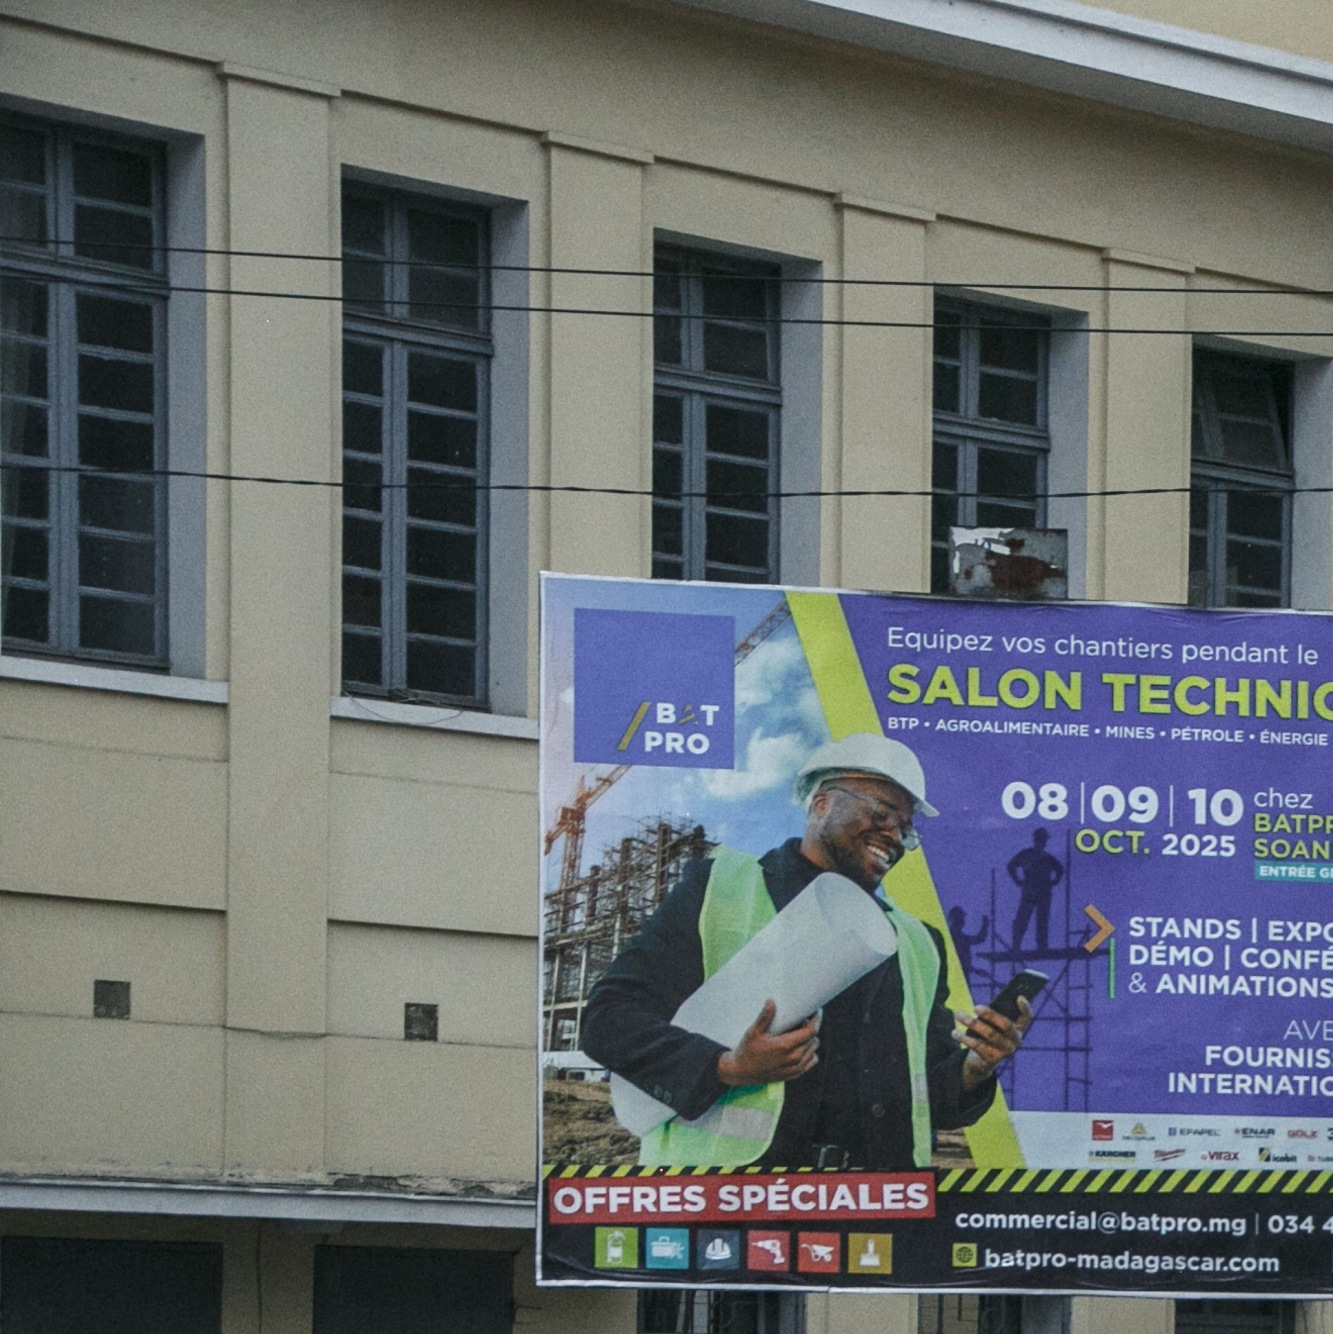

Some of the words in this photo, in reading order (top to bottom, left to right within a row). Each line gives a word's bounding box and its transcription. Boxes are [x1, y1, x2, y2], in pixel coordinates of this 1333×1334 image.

[888, 627, 993, 653] Equipez
[1002, 636, 1046, 654] vos
[1055, 634, 1173, 659] chantiers
[1182, 642, 1288, 664] pendant
[1298, 644, 1318, 665] le
[887, 663, 1082, 710] SALON
[644, 731, 710, 754] PRO
[888, 717, 919, 730] BTP
[935, 718, 1090, 737] AGROALIMENTAIRE
[1106, 726, 1155, 740] MINES
[1171, 727, 1244, 743] PÉTROLE
[1260, 729, 1328, 746] ÉNERGIE
[1001, 781, 1069, 821] 08
[1091, 785, 1159, 824] 09
[1188, 788, 1244, 827] 10
[1254, 787, 1313, 809] chez
[1075, 828, 1150, 855] OCT.
[1161, 833, 1236, 857] 2025
[1259, 863, 1316, 879] ENTRÉE
[1129, 916, 1242, 940] STANDS
[1129, 940, 1214, 967] DÉMO
[1128, 972, 1147, 994] &
[1179, 1128, 1220, 1137] EFAPEL
[1242, 1127, 1276, 1136] ENAR
[553, 1184, 707, 1214] OFFRES
[718, 1177, 930, 1212] SPÉCIALES
[955, 1211, 1247, 1237] commercial@batpro.mg
[1267, 1214, 1315, 1235] 034
[984, 1248, 1280, 1274] batpro-madagascar.com
